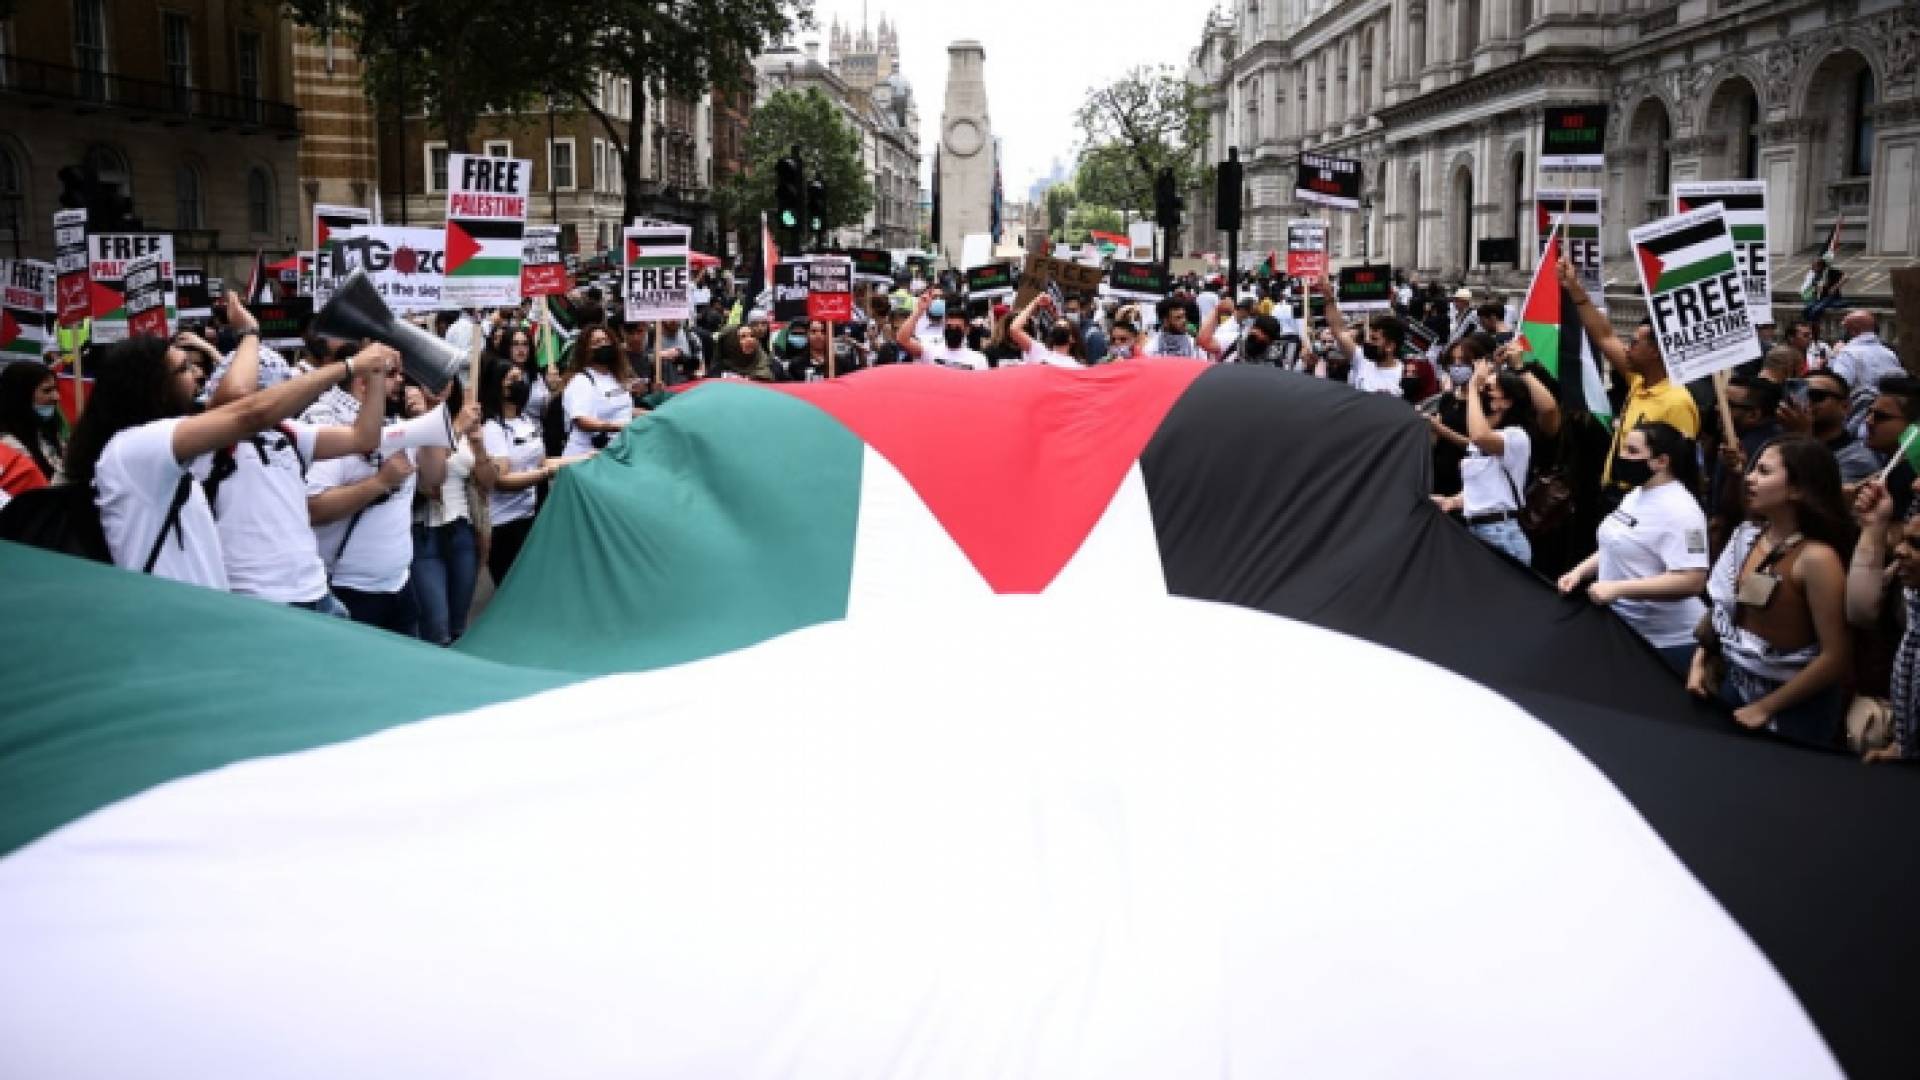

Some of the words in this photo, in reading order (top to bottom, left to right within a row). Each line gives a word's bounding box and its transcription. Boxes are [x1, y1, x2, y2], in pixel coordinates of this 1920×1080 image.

[462, 158, 521, 193] FREE
[450, 194, 524, 217] PALESTINE
[99, 237, 160, 260] FREE
[12, 262, 43, 289] FREE
[628, 269, 687, 290] FREE
[1652, 271, 1744, 332] FREE
[1660, 310, 1748, 352] PALESTINE
